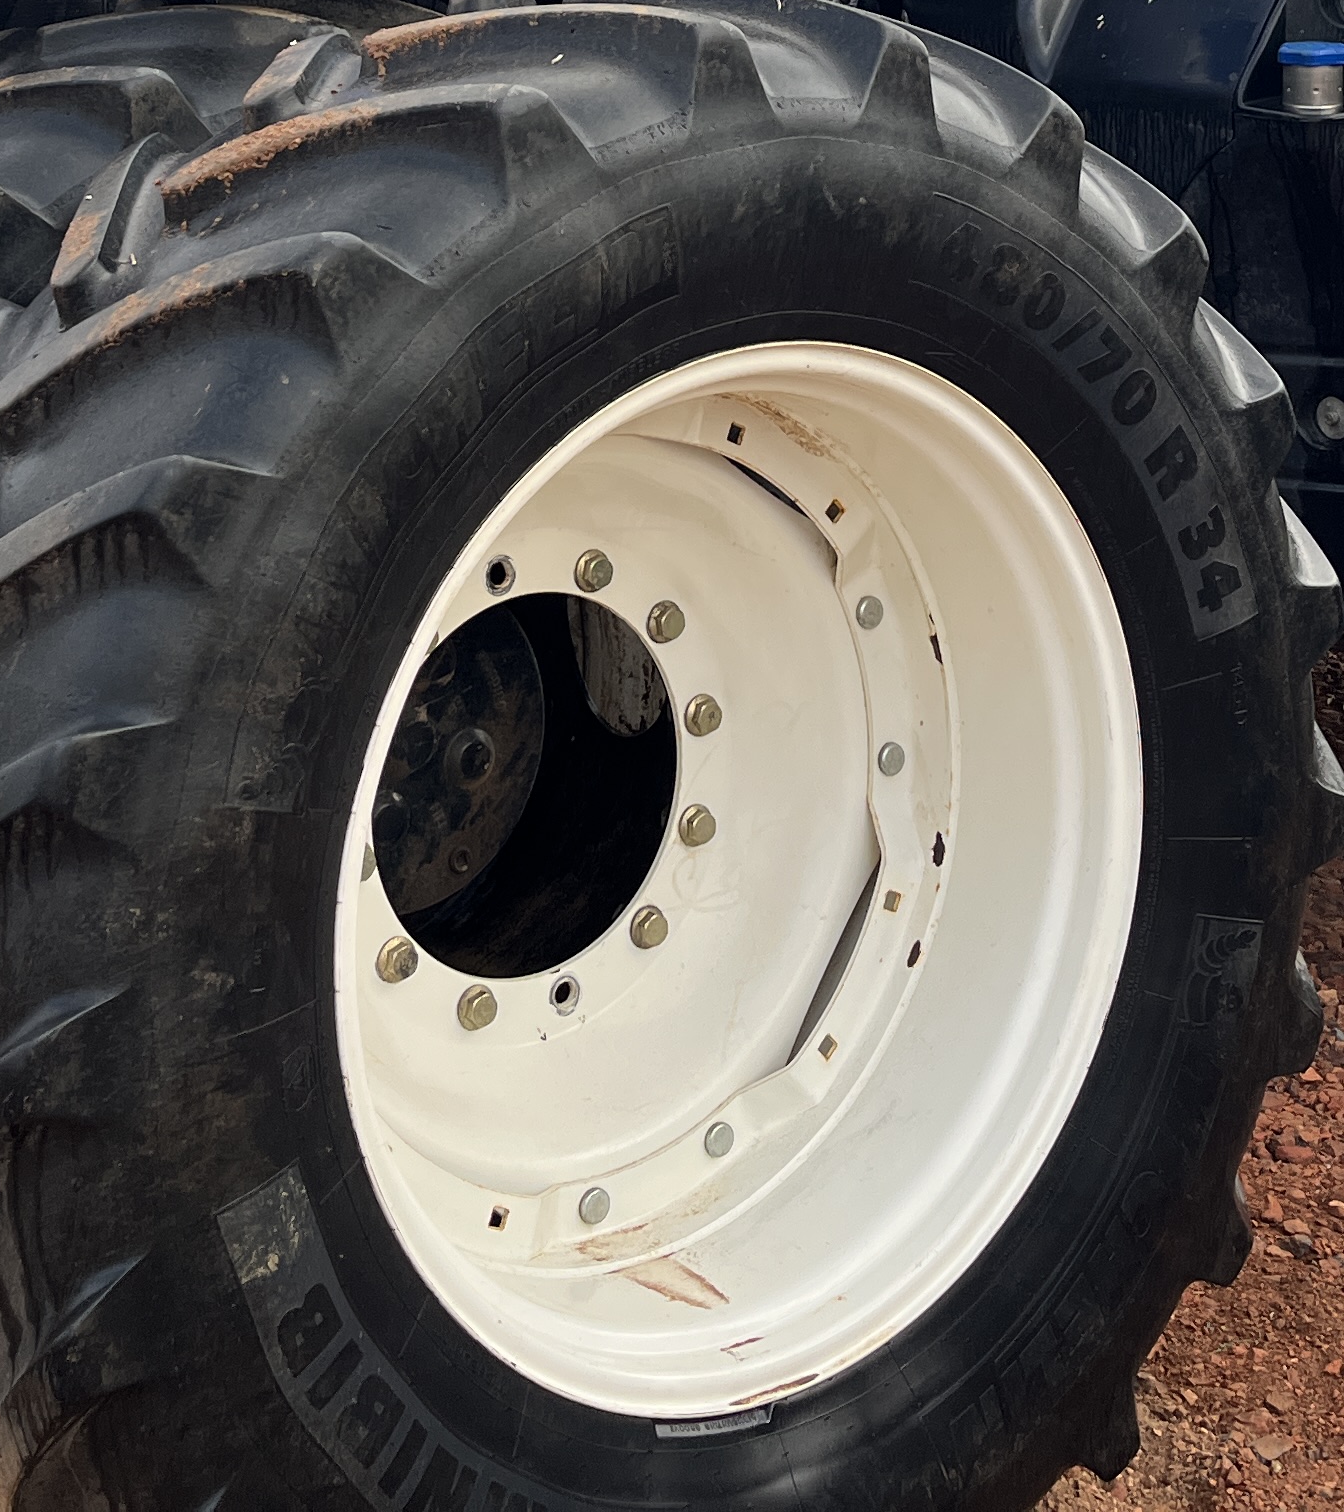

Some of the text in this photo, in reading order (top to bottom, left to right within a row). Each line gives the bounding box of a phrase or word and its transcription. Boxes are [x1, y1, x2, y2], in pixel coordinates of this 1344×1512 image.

[940, 221, 1157, 427] 480/70
[1144, 425, 1198, 502] R
[1178, 504, 1242, 612] 34
[276, 1284, 546, 1512] NIBIB
